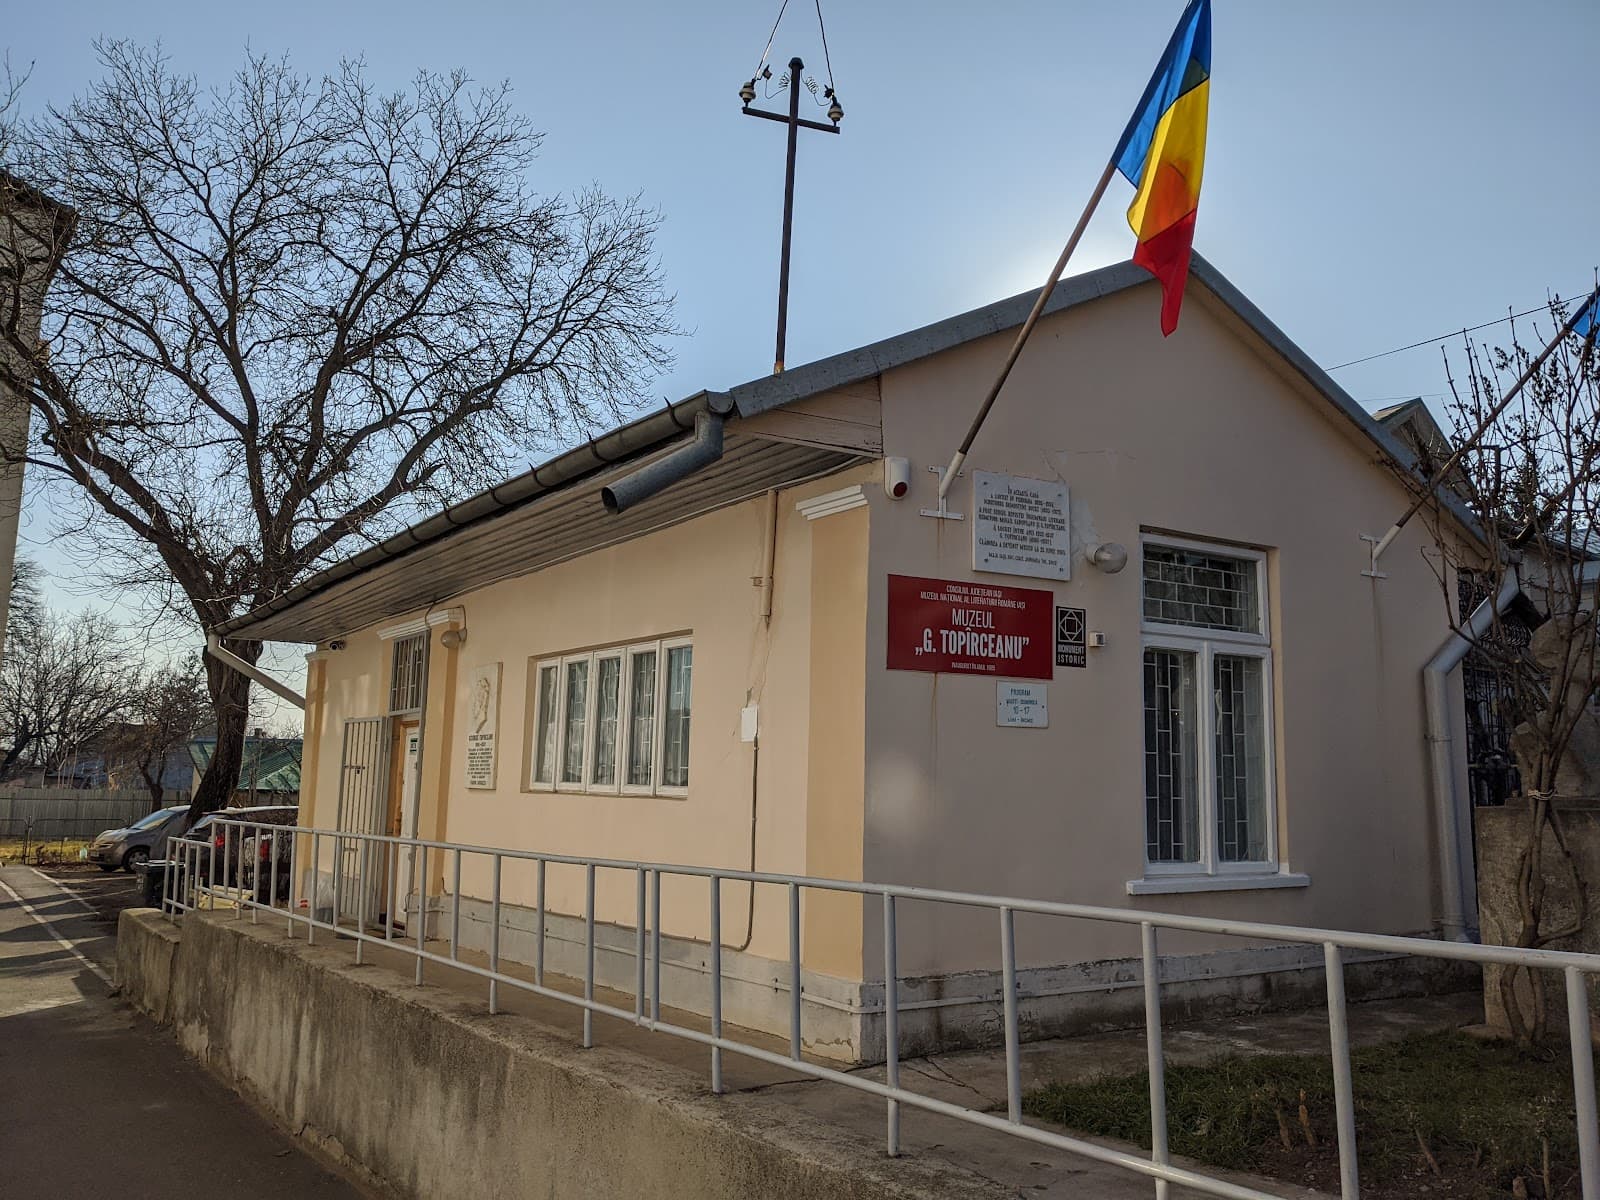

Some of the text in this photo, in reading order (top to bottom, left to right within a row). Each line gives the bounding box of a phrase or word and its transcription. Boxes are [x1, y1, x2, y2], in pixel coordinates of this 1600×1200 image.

[920, 591, 939, 601] MUZEUL
[952, 608, 995, 629] MUZEUL
[940, 625, 1029, 660] TOPÎRCEANU”
[1058, 644, 1084, 655] MONUMENT
[1058, 654, 1085, 665] ISTORIC
[1010, 688, 1031, 696] PROGRAM
